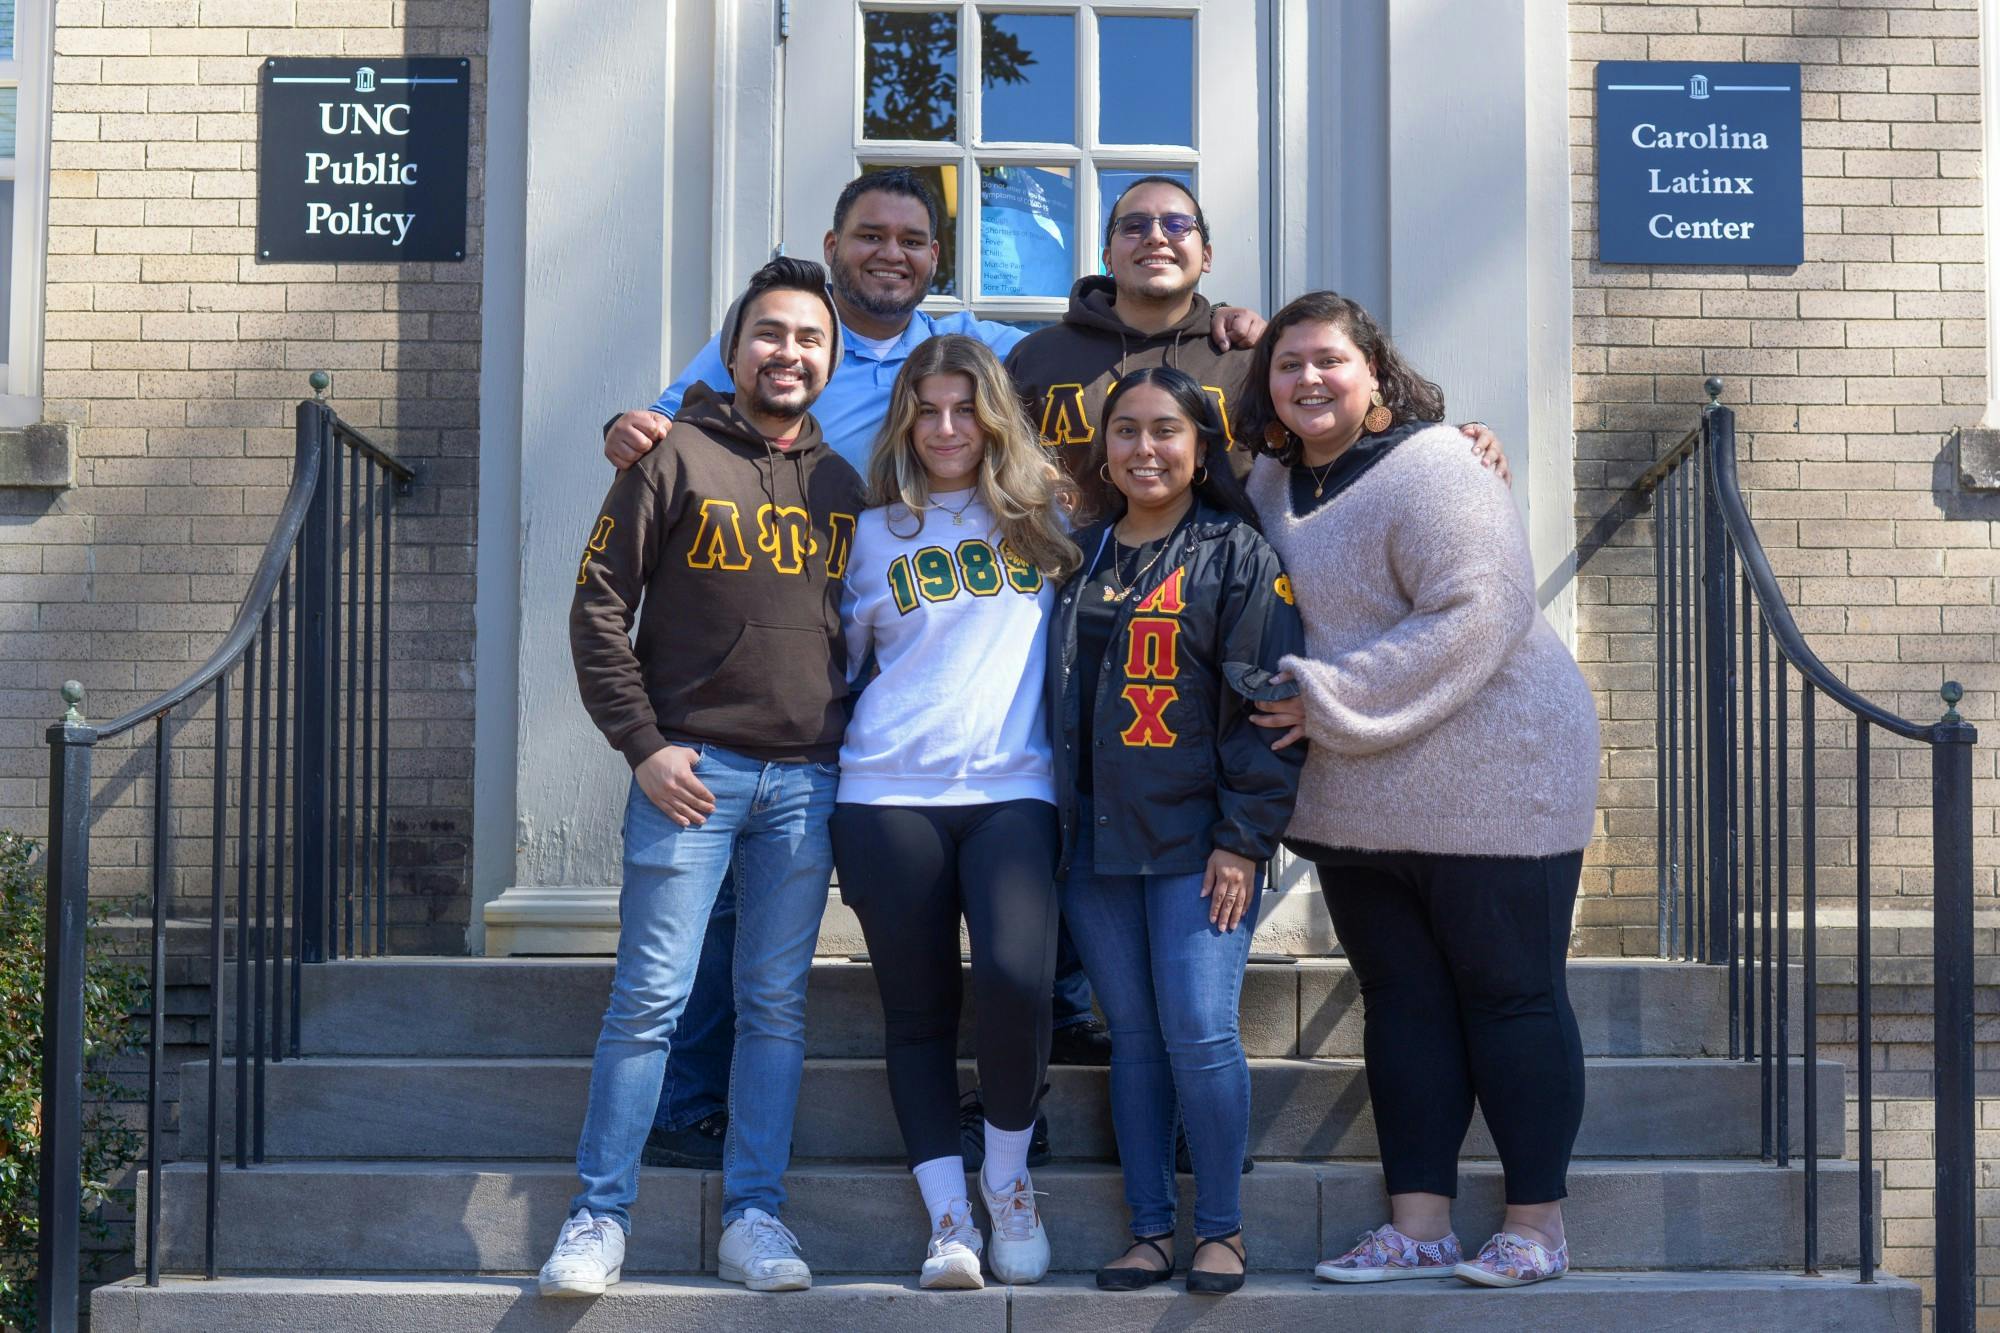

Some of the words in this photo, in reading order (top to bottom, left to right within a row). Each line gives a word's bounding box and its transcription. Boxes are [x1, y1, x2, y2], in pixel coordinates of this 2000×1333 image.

[319, 102, 411, 136] UNC
[1631, 123, 1769, 150] Carolina
[304, 152, 418, 185] Public
[1648, 168, 1754, 195] Latinx
[305, 202, 416, 246] Policy
[1648, 213, 1755, 240] Center
